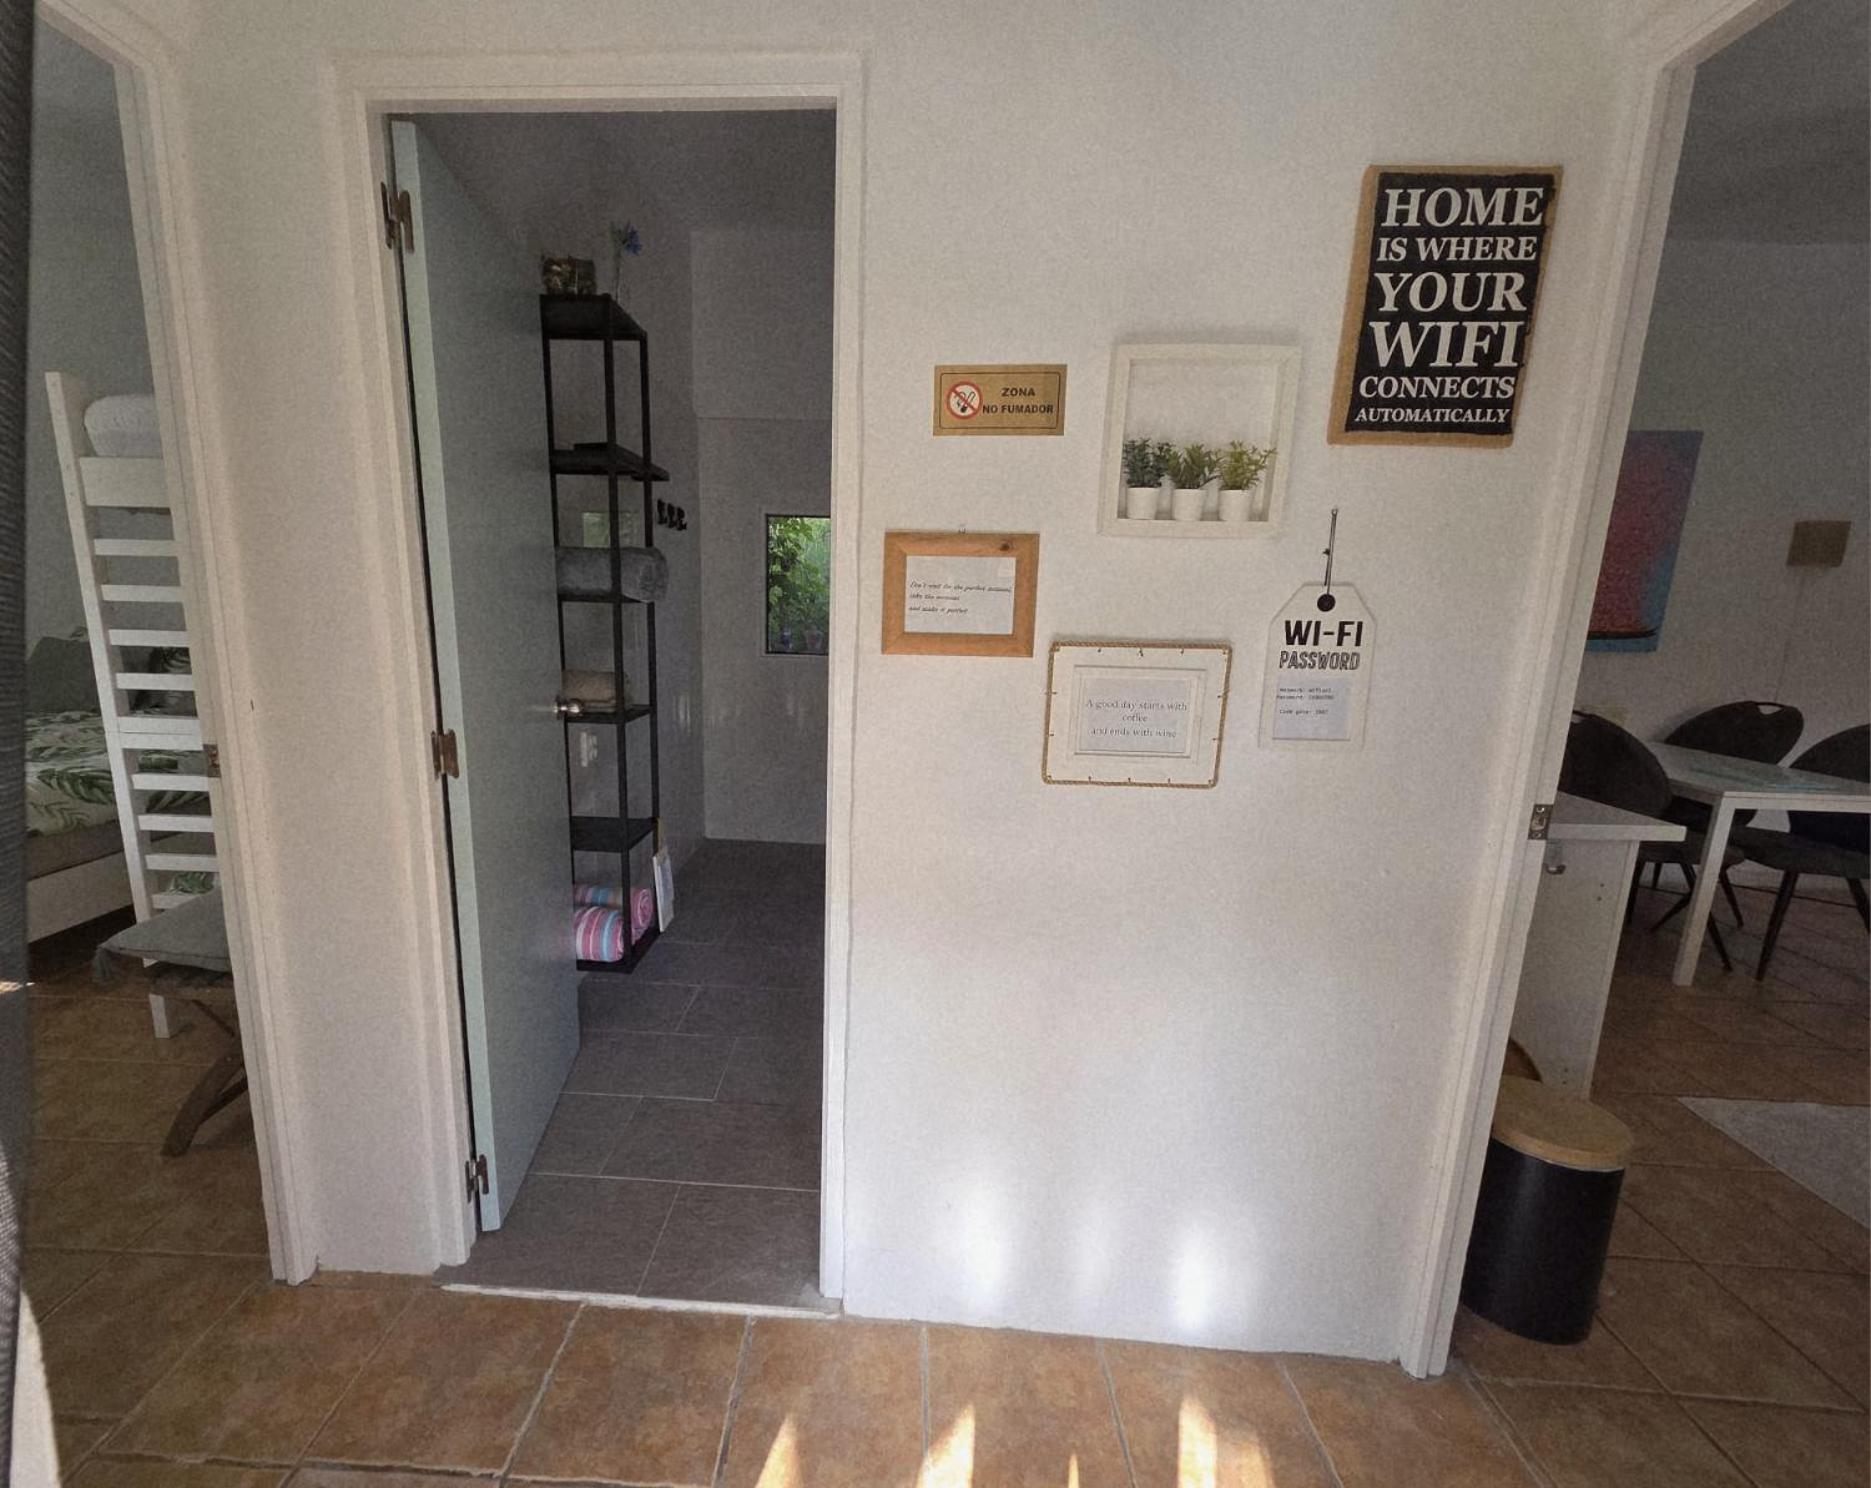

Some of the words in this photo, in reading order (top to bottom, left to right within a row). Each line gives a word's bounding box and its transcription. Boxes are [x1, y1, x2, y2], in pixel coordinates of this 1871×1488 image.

[1380, 186, 1544, 227] HOME
[1376, 236, 1408, 262] IS
[1416, 236, 1538, 262] WHERE
[1374, 271, 1527, 313] YOUR
[1368, 320, 1525, 368] WIFI
[1001, 387, 1036, 398] ZONA
[1359, 375, 1516, 399] CONNECTS
[982, 404, 999, 414] NO
[1001, 404, 1054, 414] FUMADOR
[1355, 407, 1511, 423] AUTOMATICALLY
[1284, 620, 1363, 647] WI-FI
[1279, 650, 1361, 671] PASSWORD
[1086, 699, 1093, 708] A
[1094, 700, 1119, 711] good
[1121, 700, 1136, 712] day
